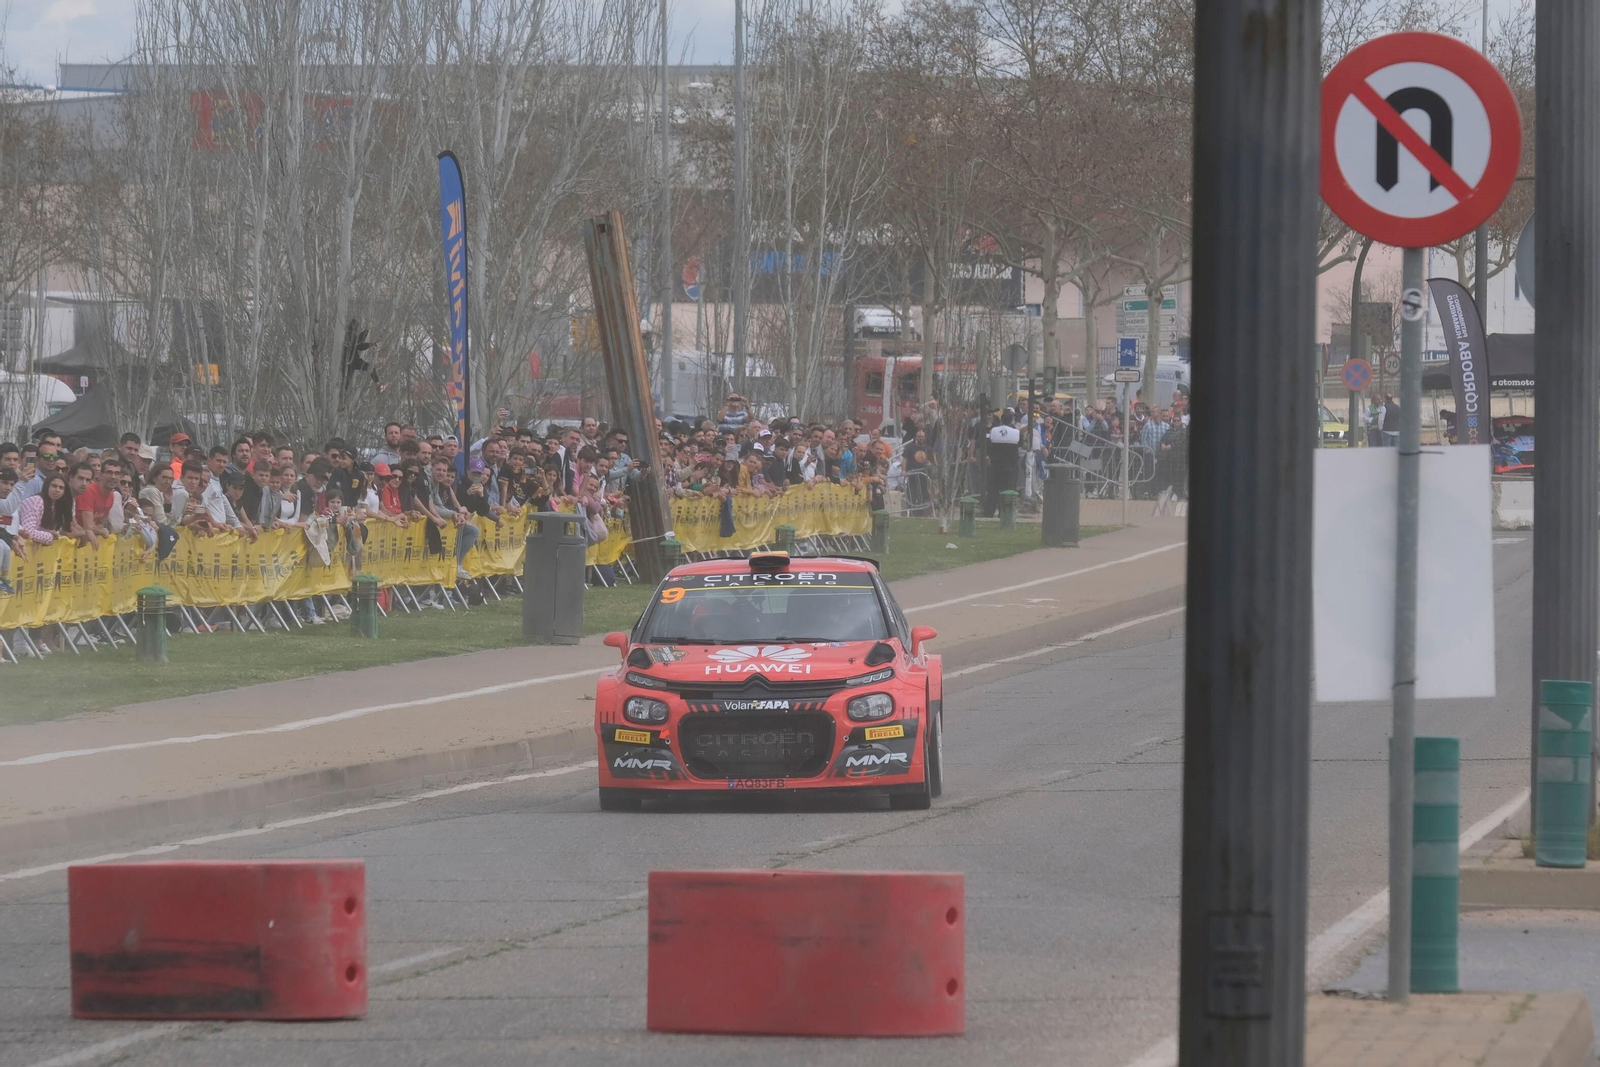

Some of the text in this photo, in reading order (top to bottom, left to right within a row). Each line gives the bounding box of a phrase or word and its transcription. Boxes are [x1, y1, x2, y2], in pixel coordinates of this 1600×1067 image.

[1387, 360, 1398, 369] 70
[660, 587, 686, 604] 9
[705, 663, 811, 675] HUAWEI
[757, 701, 790, 710] FAPA
[617, 731, 648, 742] PIRELLI
[868, 726, 901, 739] PIRELLI
[613, 757, 672, 771] MMR
[845, 752, 908, 767] MMR
[735, 780, 785, 788] AQ83FB
